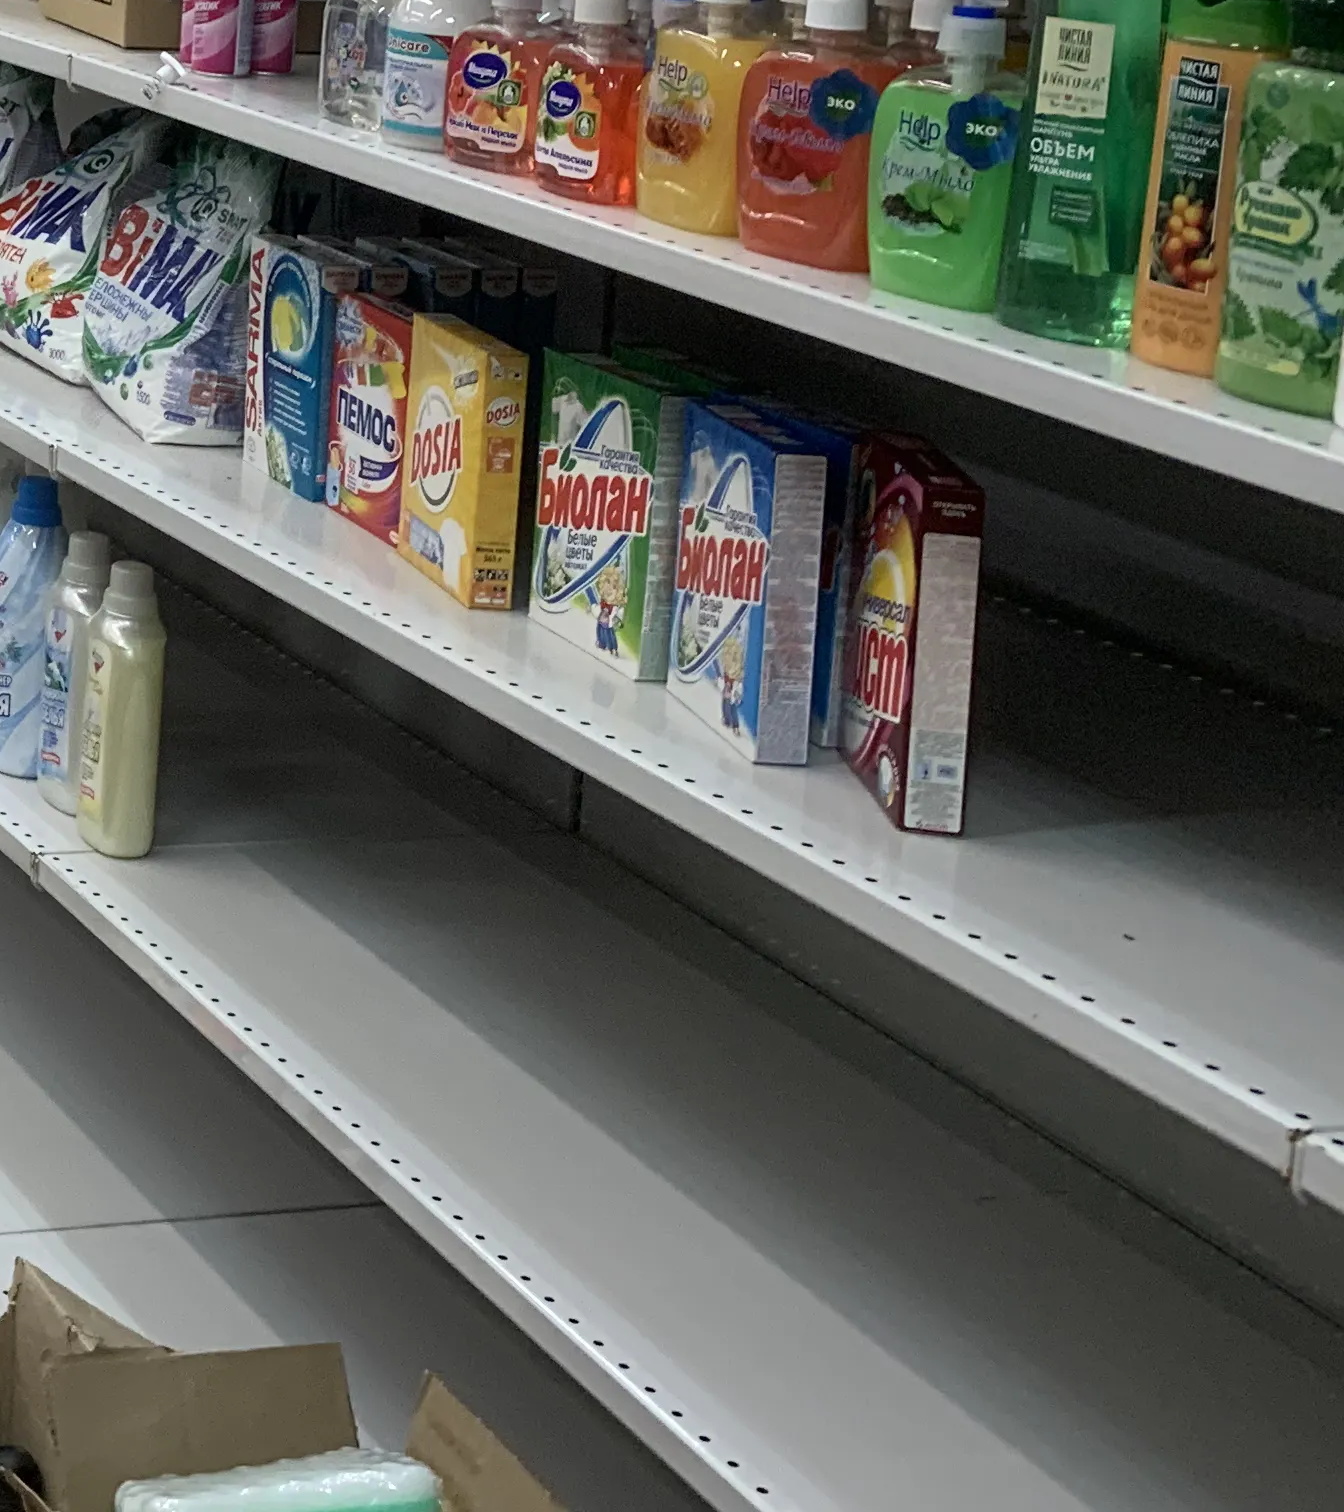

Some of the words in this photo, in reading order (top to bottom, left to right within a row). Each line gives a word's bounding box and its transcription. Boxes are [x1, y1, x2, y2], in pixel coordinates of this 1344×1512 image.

[657, 55, 689, 85] Help
[1181, 59, 1219, 79] ЧИСТАЯ
[768, 76, 812, 110] Help
[827, 96, 856, 112] ЭКО
[1178, 84, 1214, 105] ЛИНИЯ
[965, 121, 999, 137] ЭКО
[1029, 154, 1061, 167] УЛЬТРА
[1030, 137, 1096, 163] ОБЪЕМ
[1028, 163, 1093, 181] УВЛАЖНЕНИЕ
[87, 290, 129, 321] ЕРШИНЫ
[94, 276, 154, 322] ЕЛОСНЕЖНЫ
[247, 248, 265, 432] SARMA
[337, 386, 396, 453] ПЕМОС
[486, 402, 521, 425] DOSIA
[411, 417, 462, 484] DOSIA
[600, 445, 640, 463] Гарантия
[599, 460, 638, 475] качества
[538, 448, 650, 534] Биолан
[567, 529, 598, 547] Белые
[565, 545, 594, 562] цветы
[677, 507, 766, 602] Биолан
